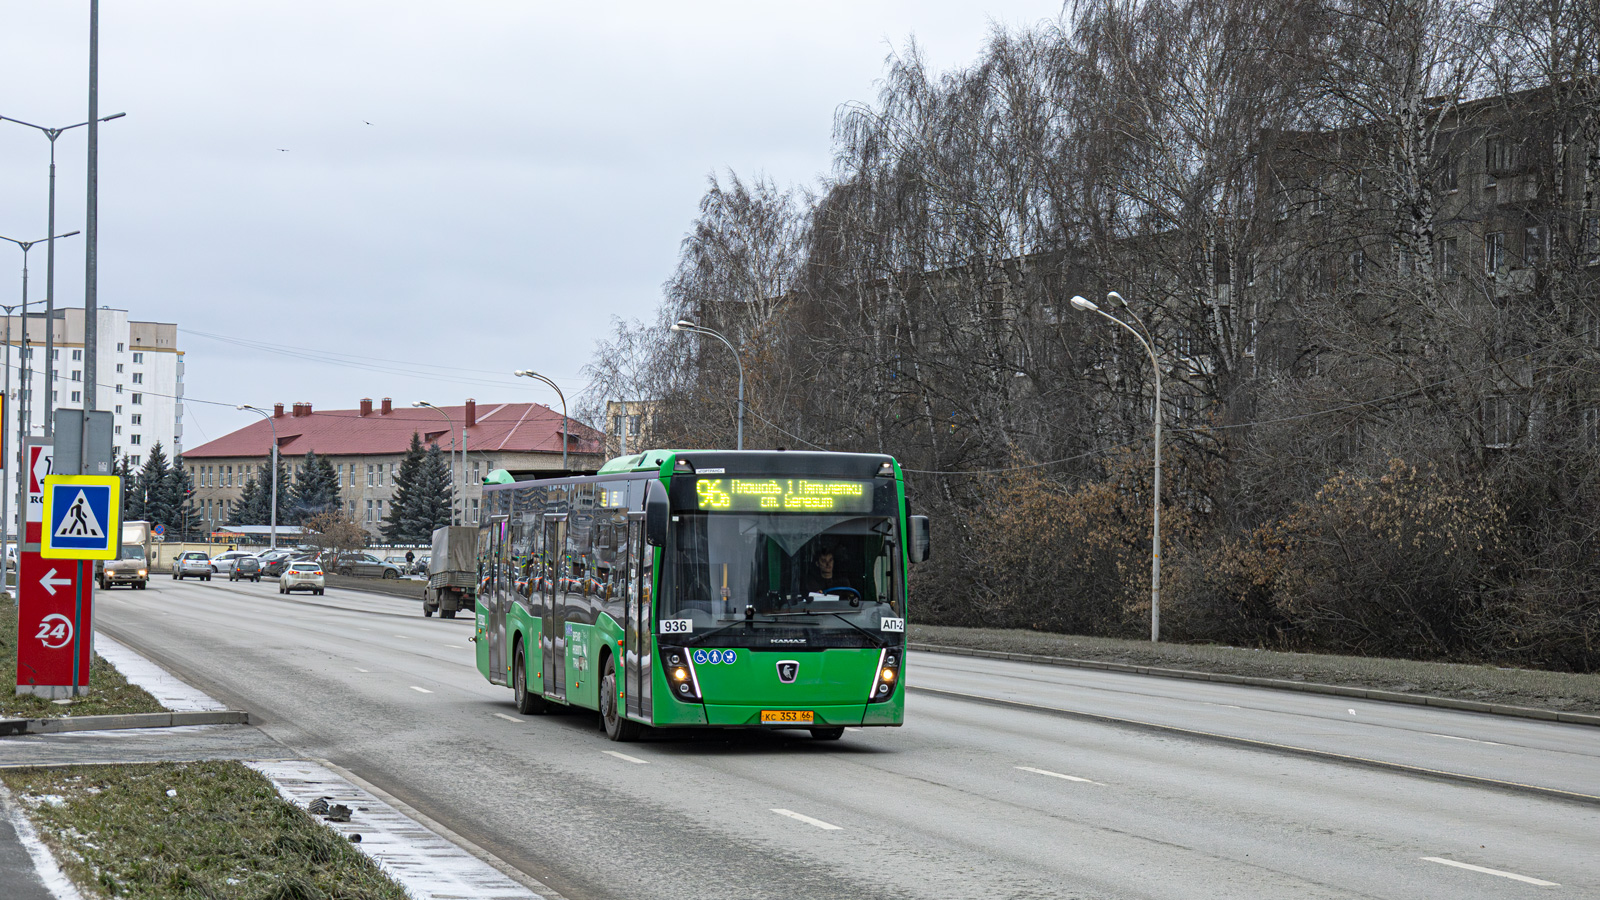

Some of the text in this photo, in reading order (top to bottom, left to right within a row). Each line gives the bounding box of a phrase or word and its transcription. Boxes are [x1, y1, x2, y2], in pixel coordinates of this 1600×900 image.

[731, 479, 863, 496] Площадь 1 Пятилетки
[35, 623, 66, 638] 24
[664, 620, 688, 632] 936
[882, 619, 904, 631] АП-2
[780, 711, 796, 721] 353
[801, 711, 810, 719] 66
